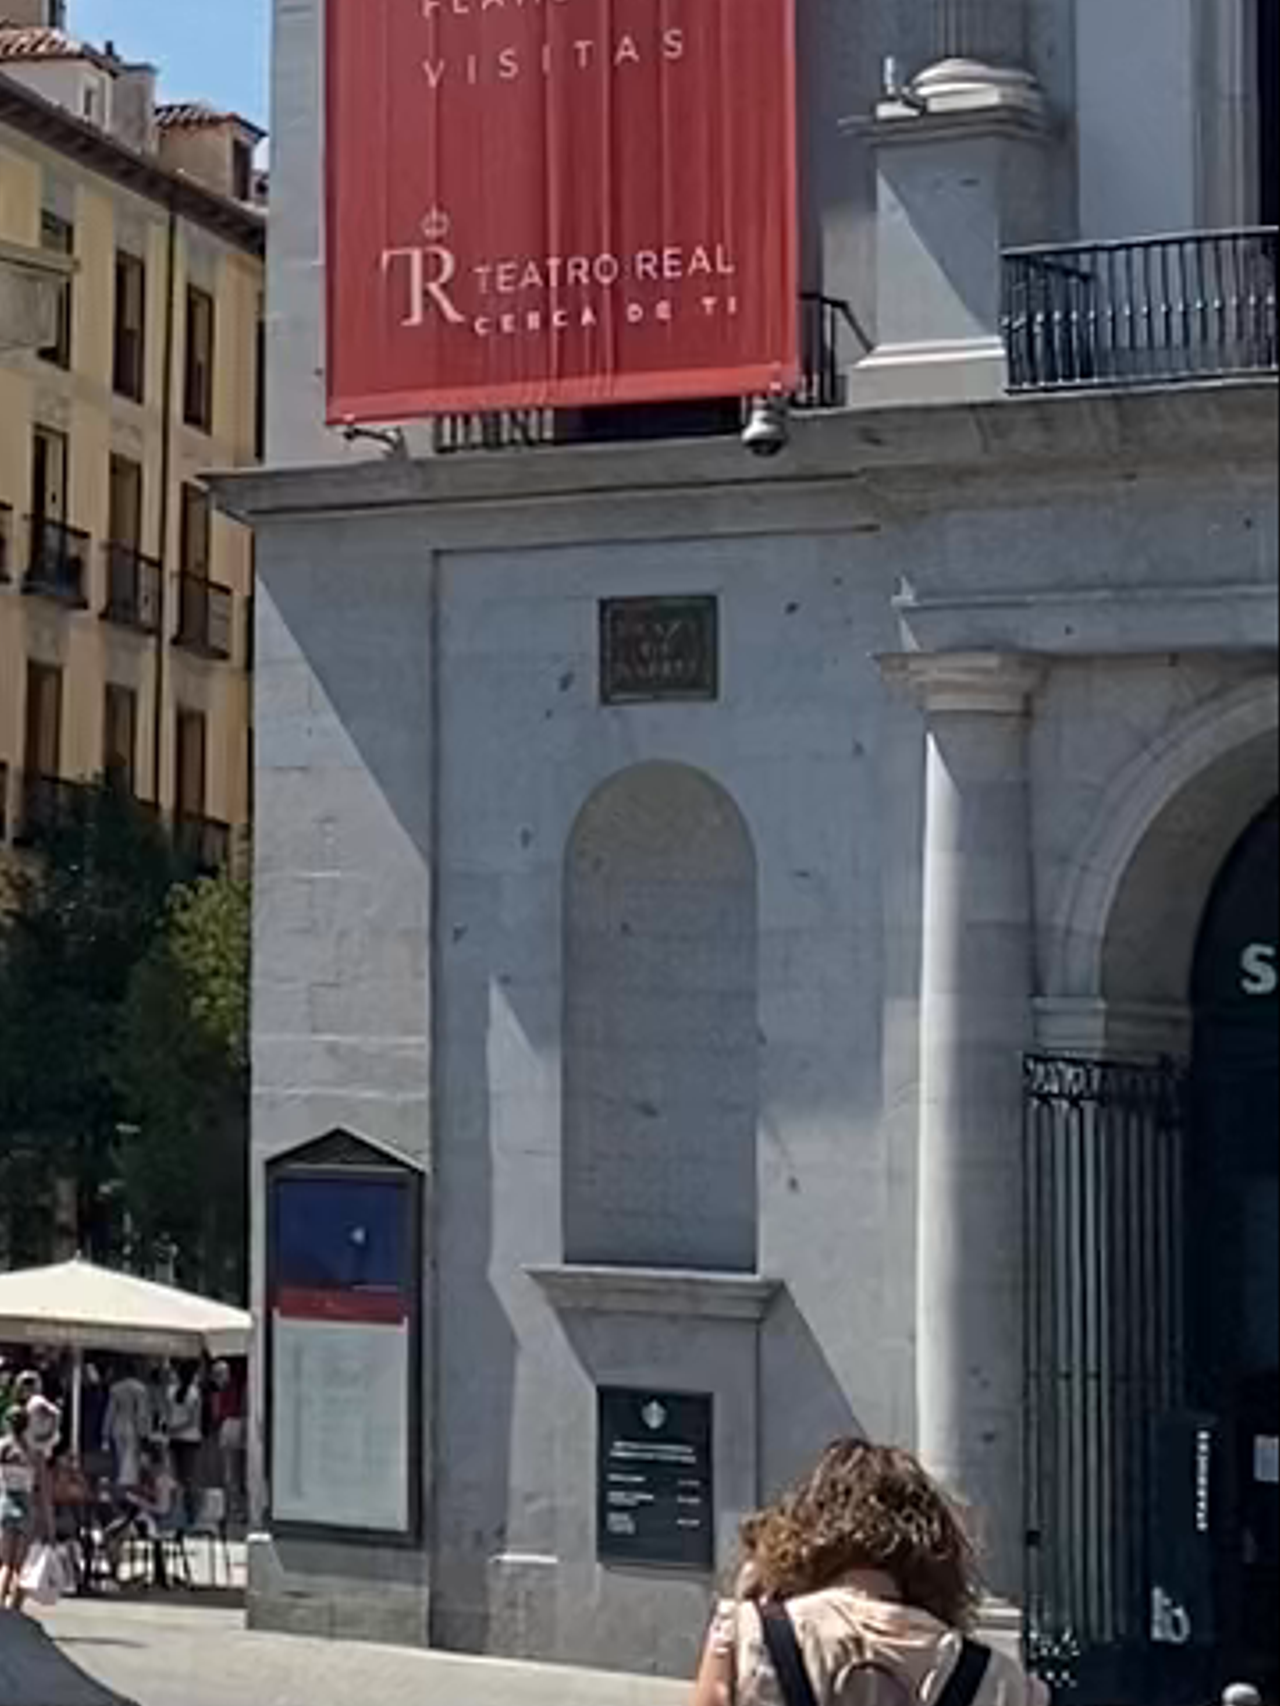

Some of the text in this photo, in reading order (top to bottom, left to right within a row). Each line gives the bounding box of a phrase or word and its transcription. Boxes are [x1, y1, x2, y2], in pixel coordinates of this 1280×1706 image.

[423, 29, 684, 88] VISITAS
[473, 253, 618, 294] TEATRO
[635, 243, 735, 281] REAL
[474, 296, 737, 336] CERCA DE TI
